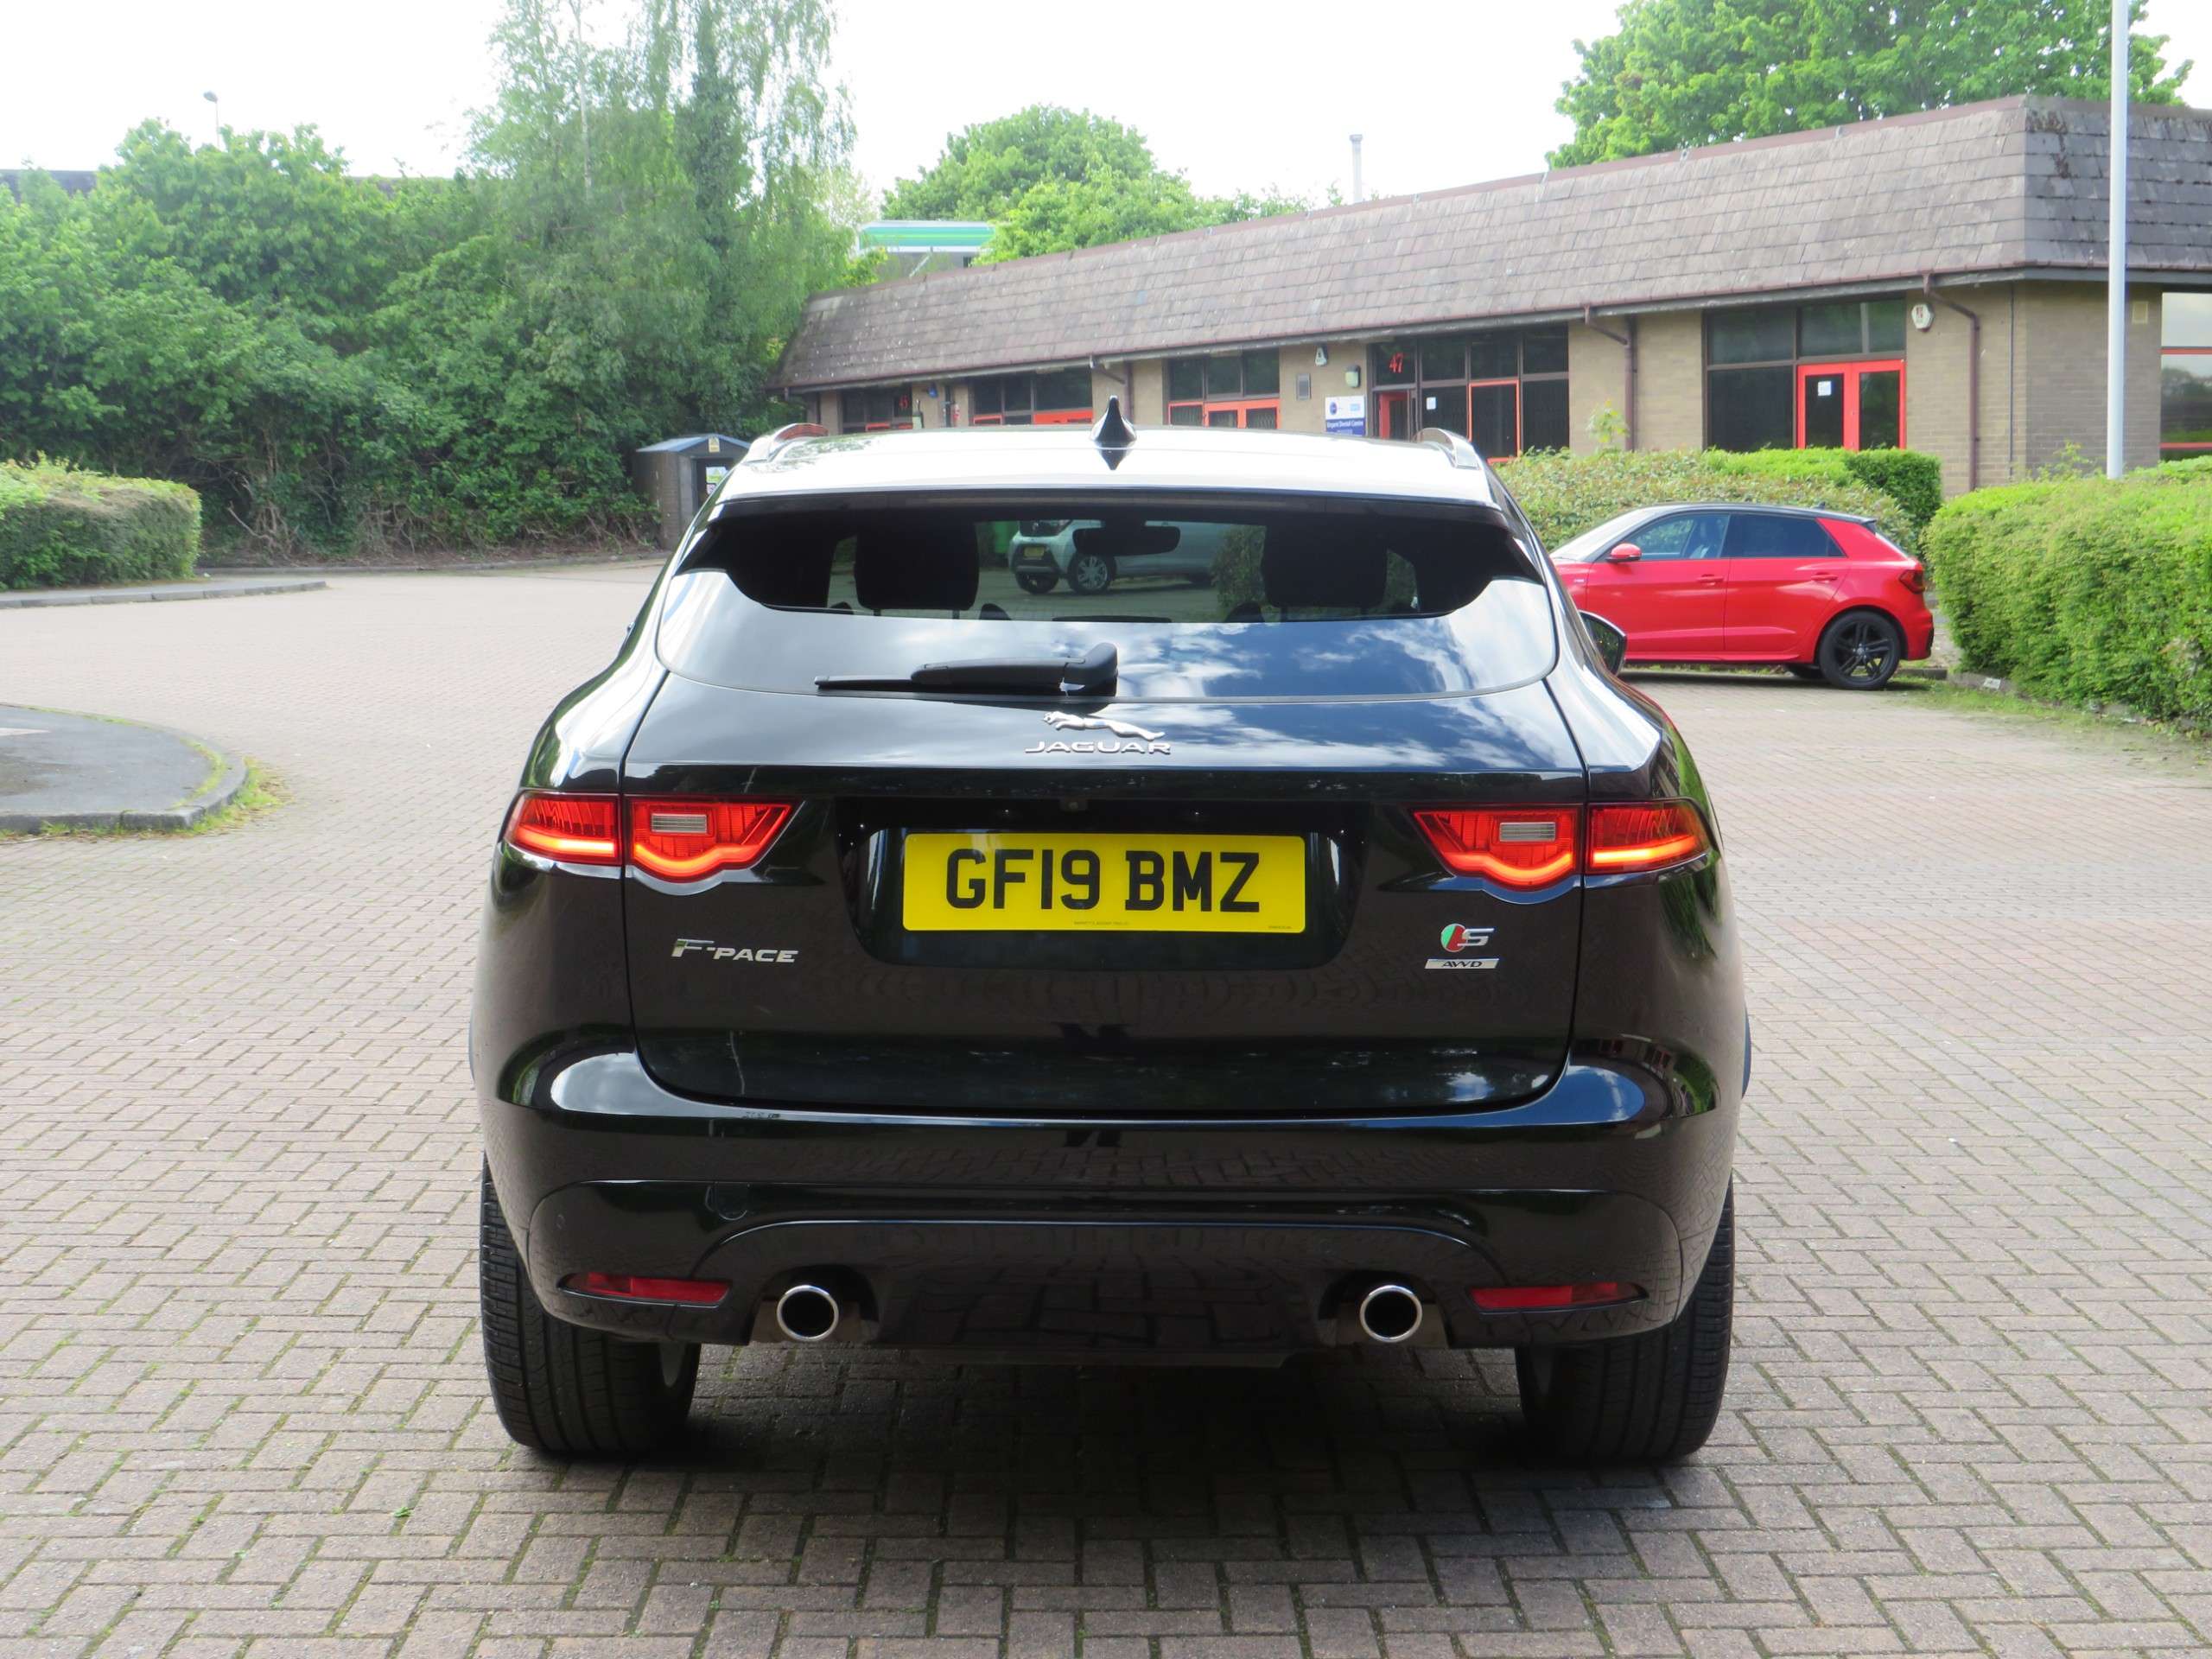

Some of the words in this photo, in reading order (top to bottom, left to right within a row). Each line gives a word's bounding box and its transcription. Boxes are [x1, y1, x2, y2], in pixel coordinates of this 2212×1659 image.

[1389, 352, 1404, 373] 47
[1025, 741, 1171, 754] JAGUAR
[945, 848, 1101, 910] GF19
[1124, 849, 1260, 913] BMZ
[671, 938, 799, 963] F-PACE
